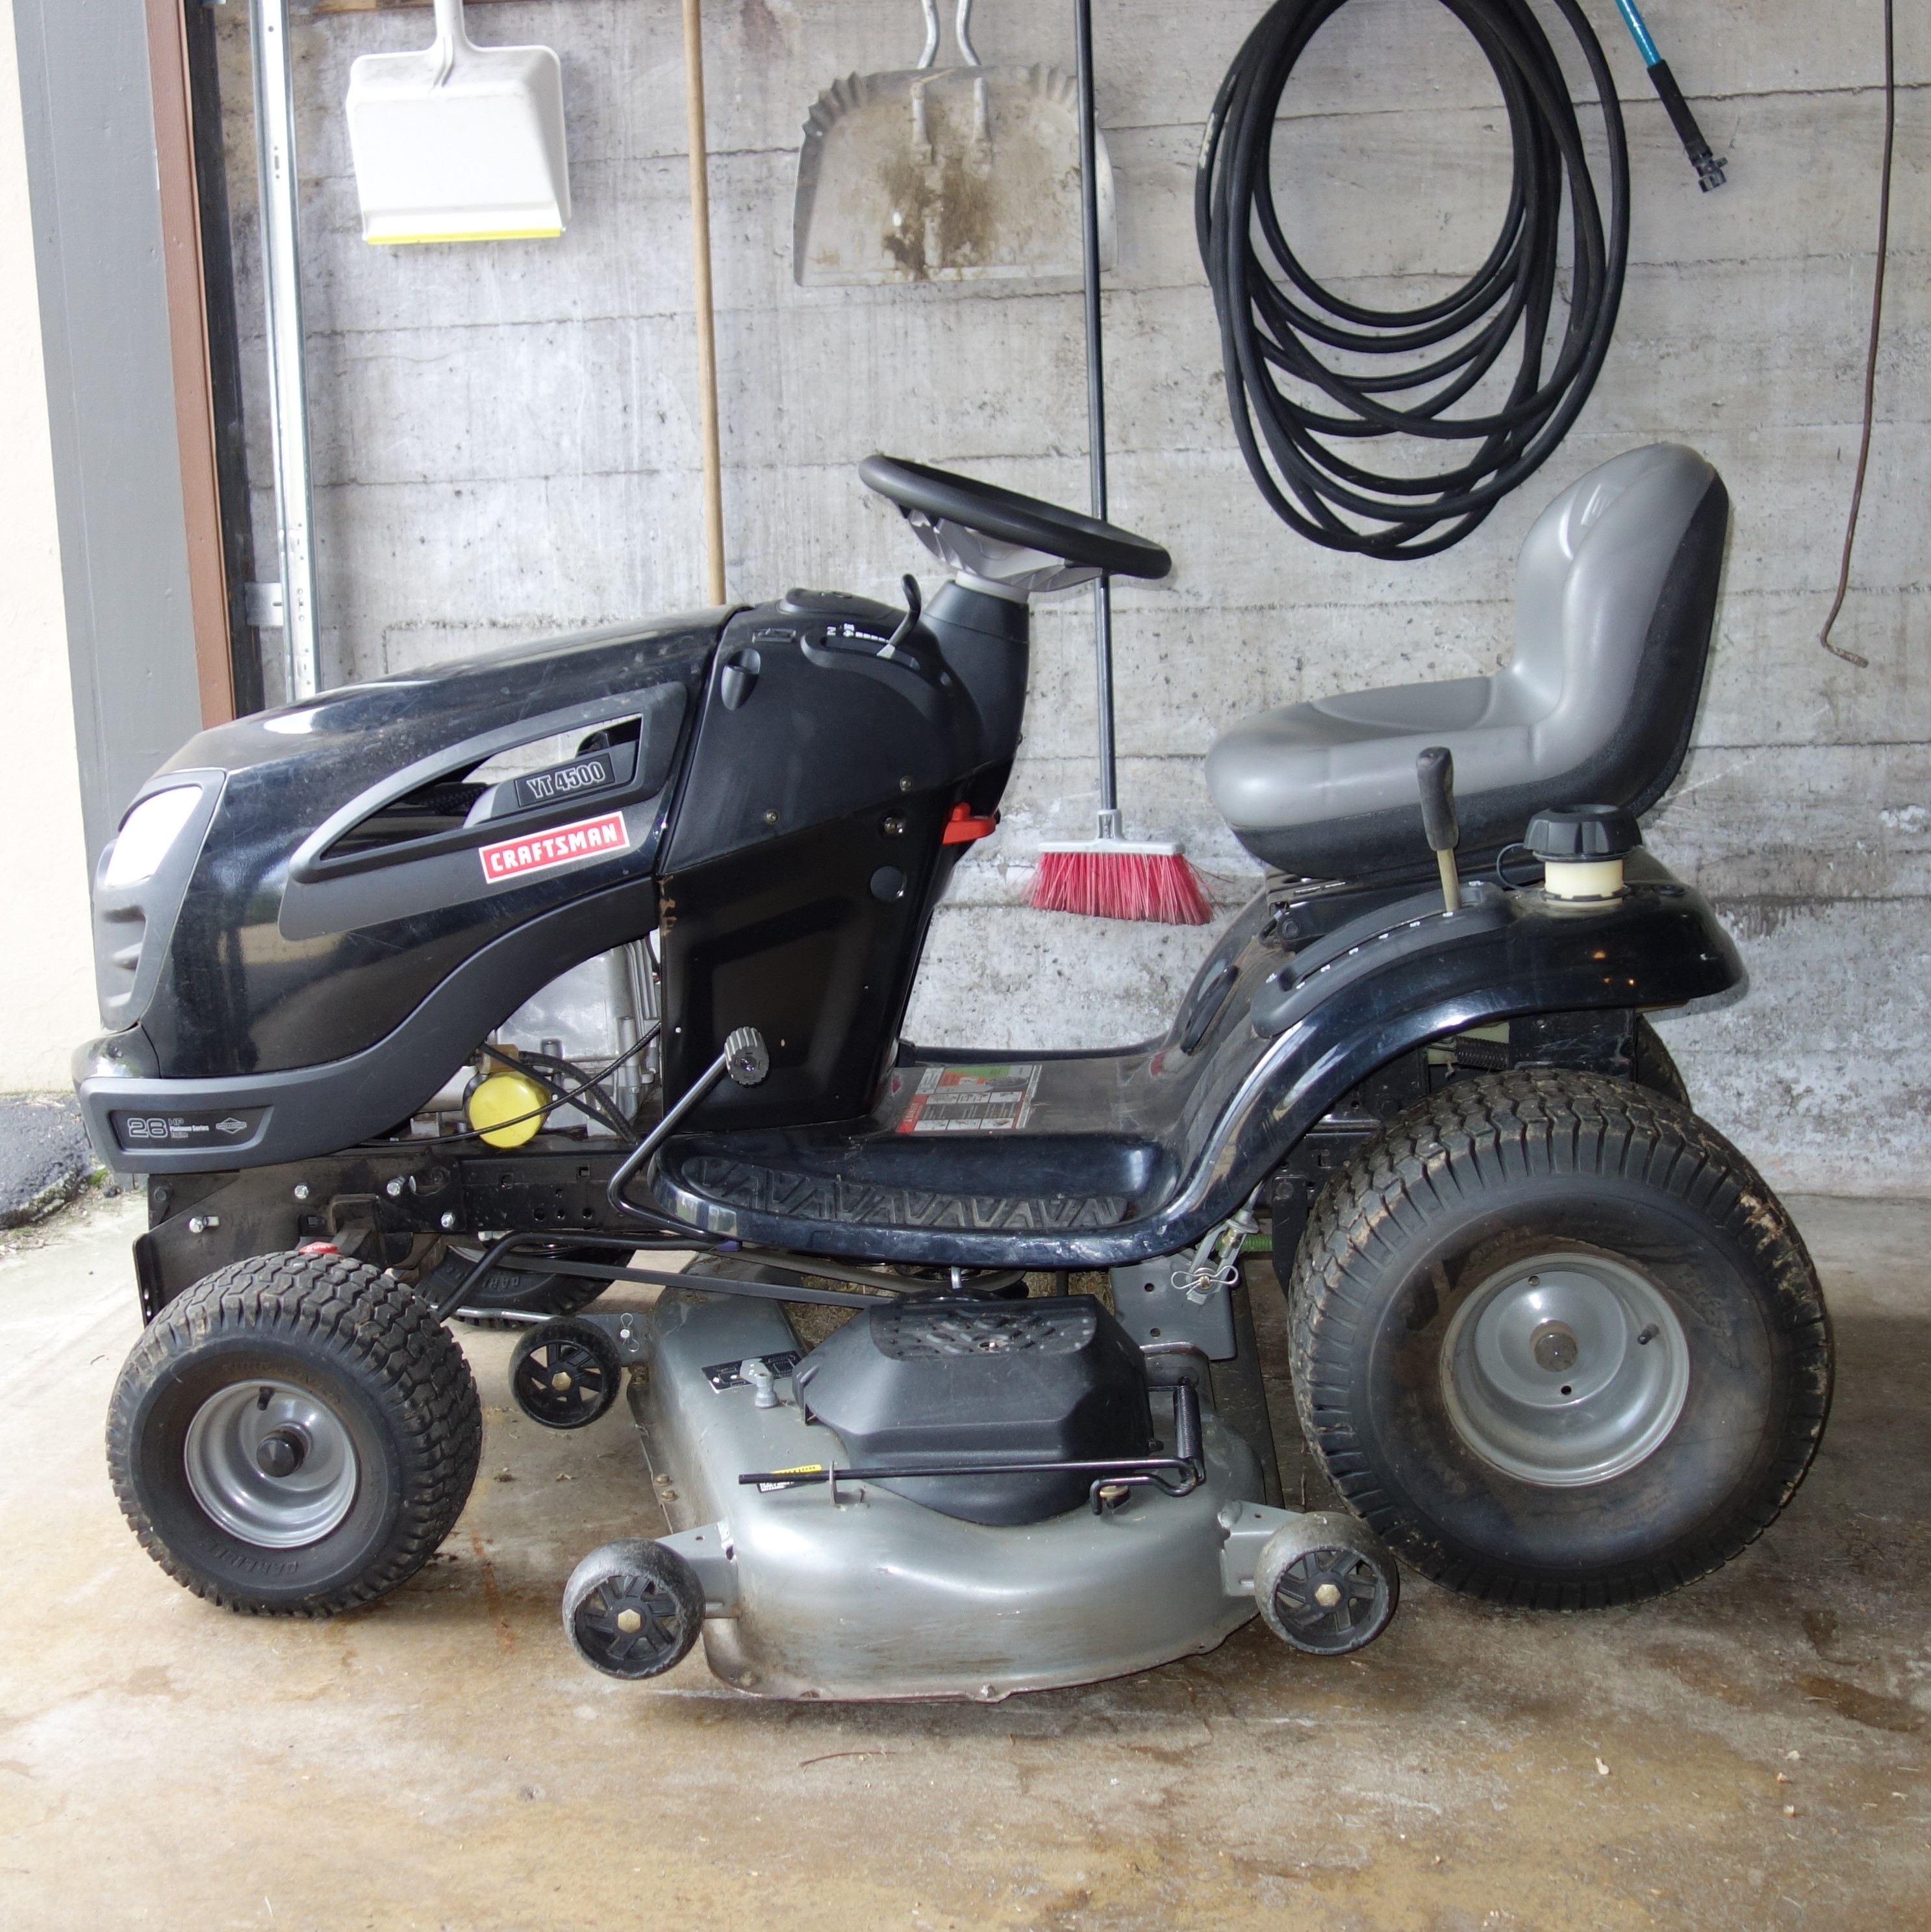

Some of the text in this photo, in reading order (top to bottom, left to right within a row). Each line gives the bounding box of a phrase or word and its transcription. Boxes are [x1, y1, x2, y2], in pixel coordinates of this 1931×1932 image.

[527, 761, 605, 799] YT 4500
[490, 822, 618, 872] CRAFTSMAN
[127, 1117, 168, 1138] 28
[168, 1117, 184, 1126] HP
